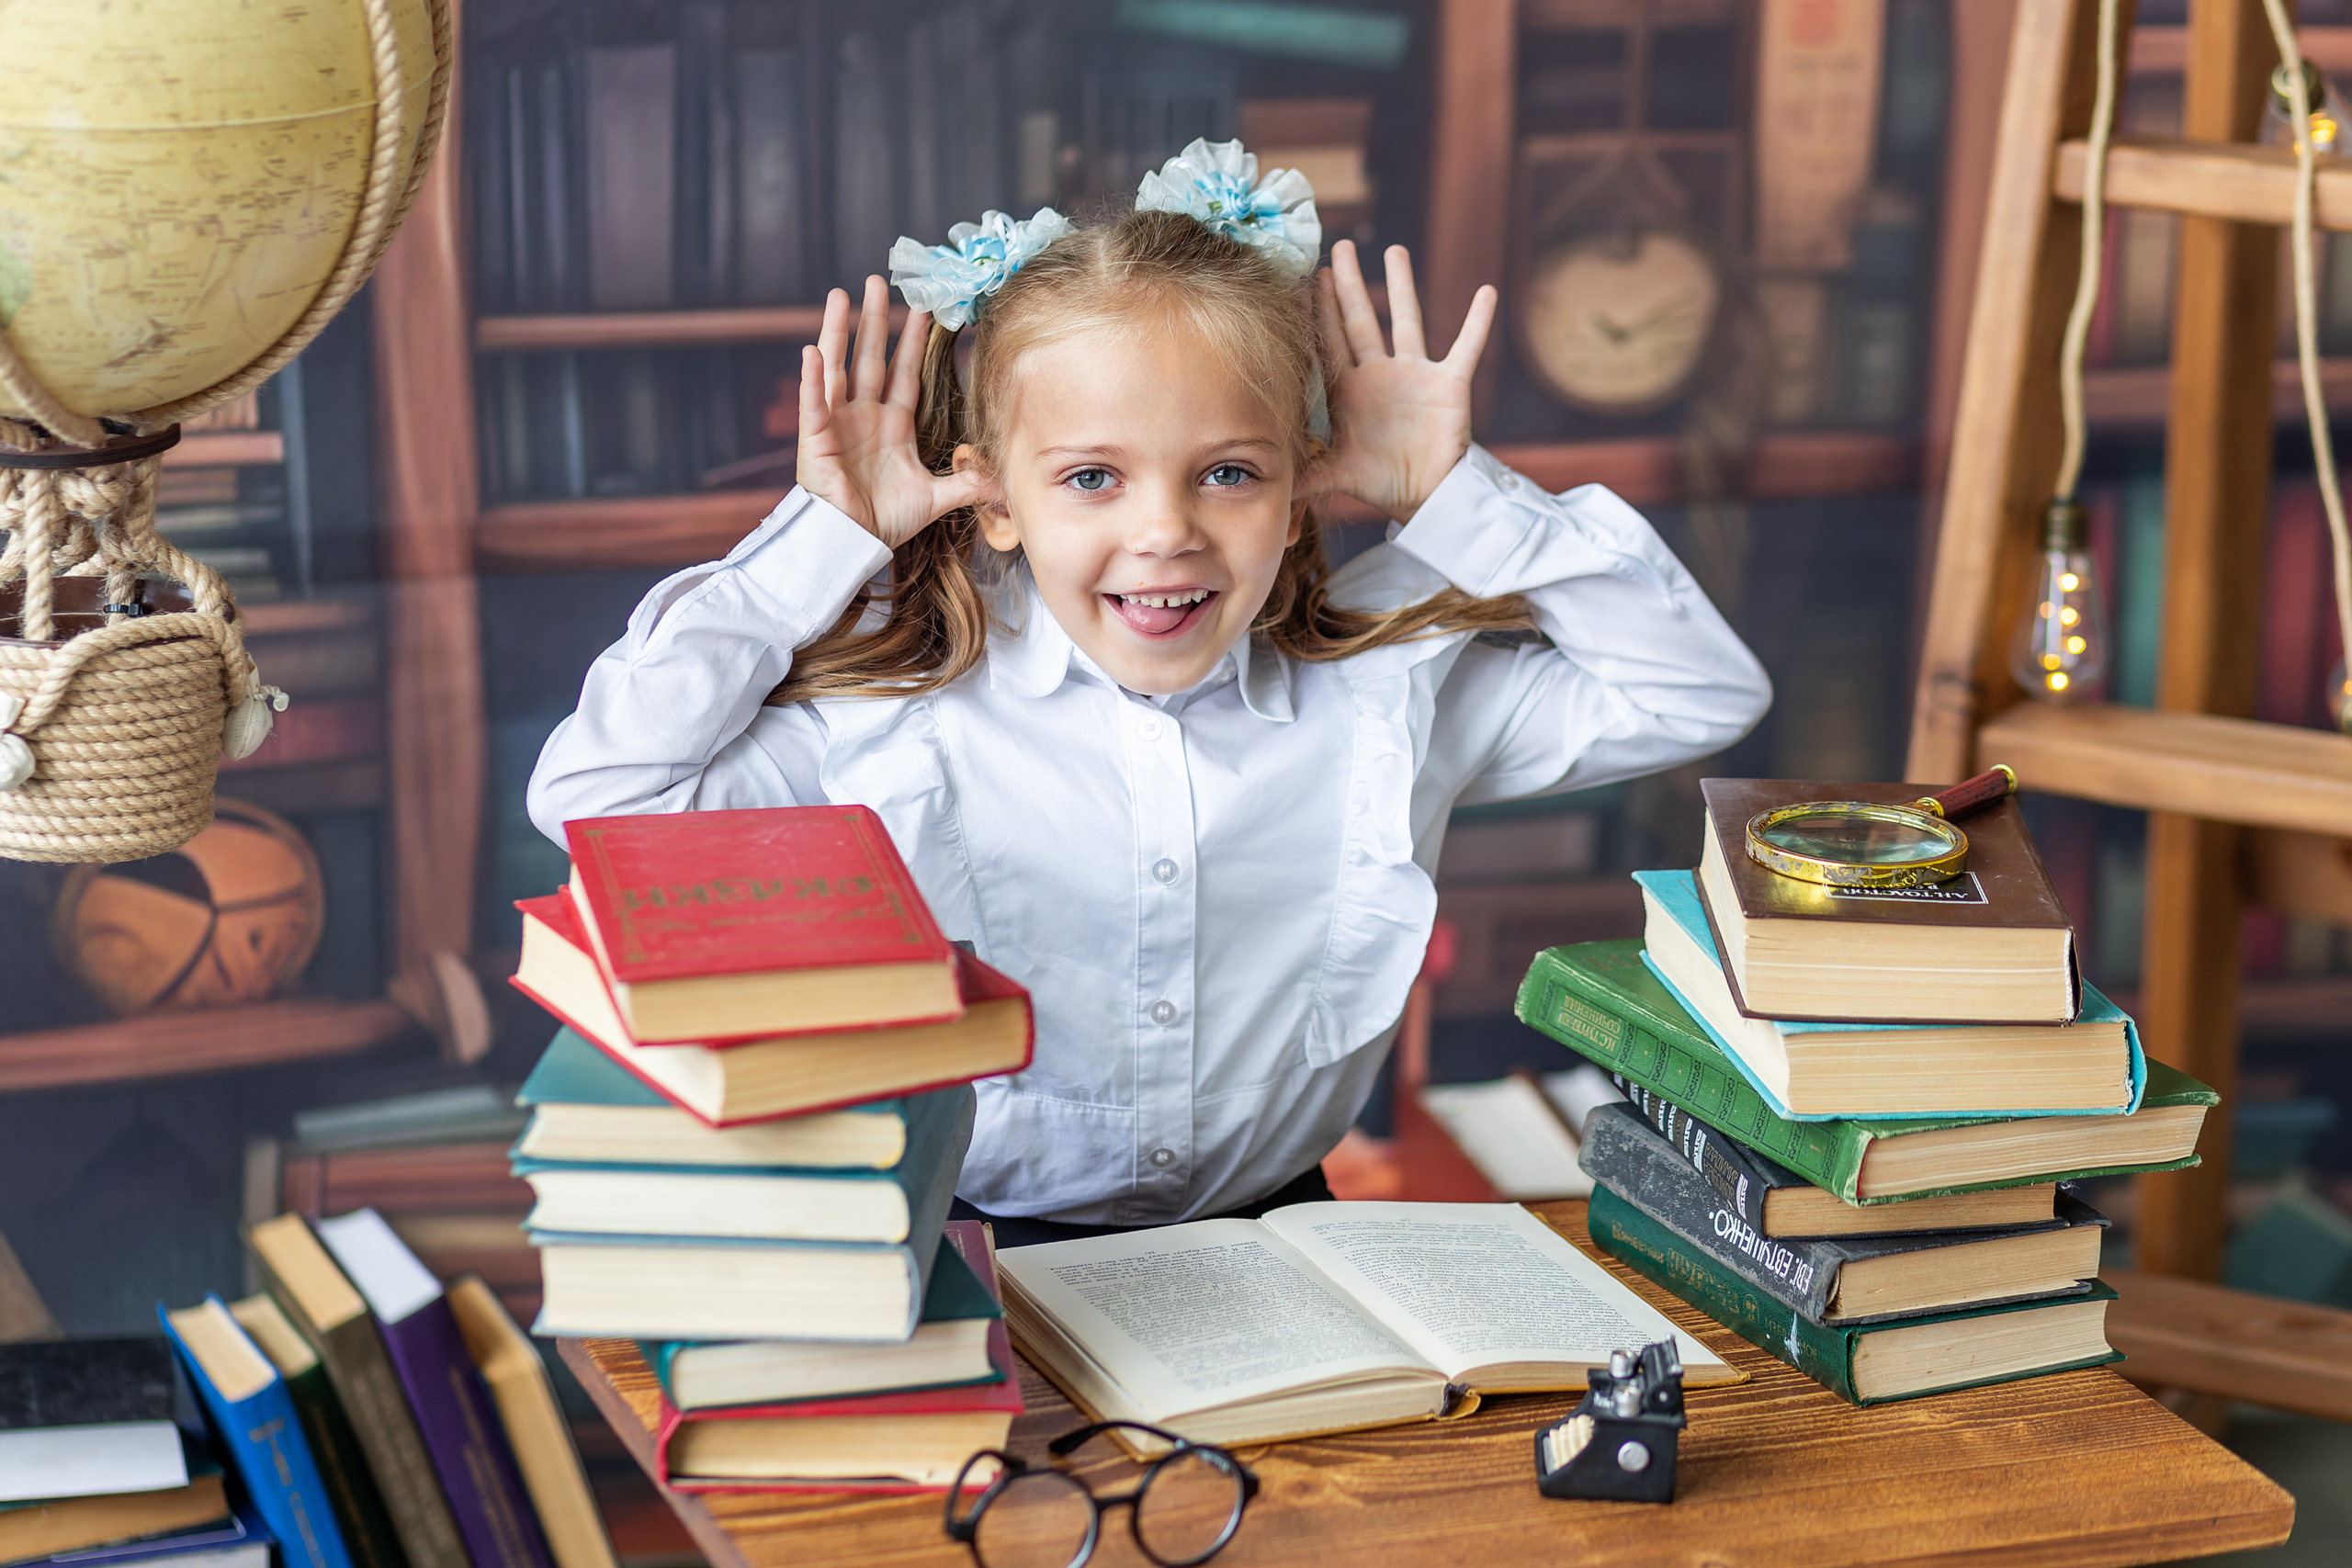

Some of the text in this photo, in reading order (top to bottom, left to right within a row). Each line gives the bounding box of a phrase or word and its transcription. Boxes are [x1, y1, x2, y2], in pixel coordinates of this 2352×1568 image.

[1564, 995, 1621, 1033] СОЧИНЕНИЯ
[1704, 1142, 1740, 1185] ВЛАДИМИР
[1790, 1258, 1815, 1296] ЕВГ.
[1763, 1316, 1818, 1362] ИЗБРНОЕ
